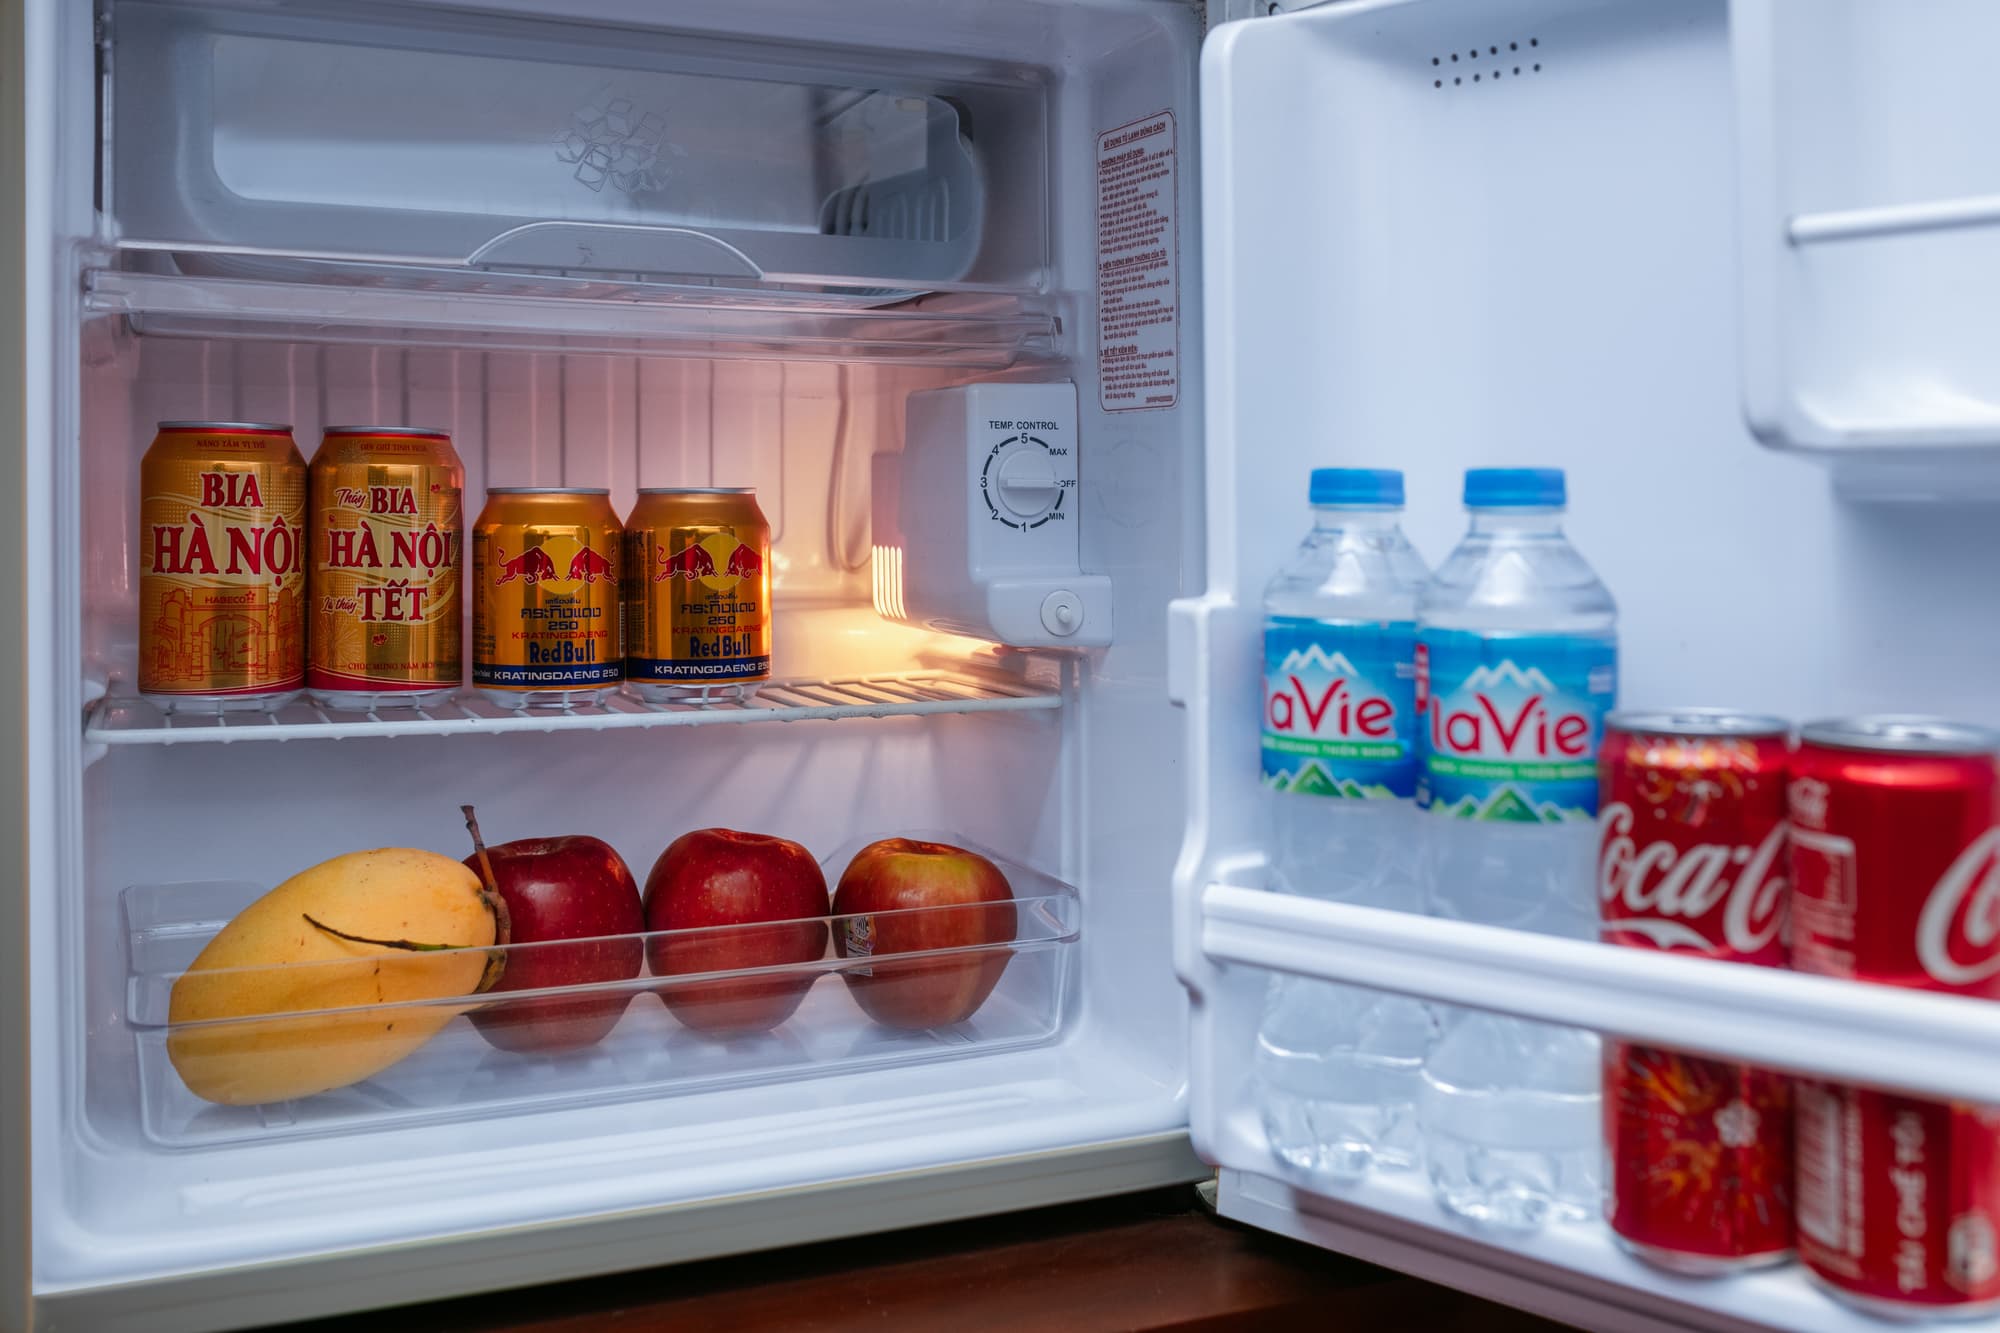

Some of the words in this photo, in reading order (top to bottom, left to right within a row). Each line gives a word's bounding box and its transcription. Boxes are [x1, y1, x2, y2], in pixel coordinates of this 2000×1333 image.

[989, 420, 1015, 430] TEMP.
[1016, 421, 1059, 430] CONTROL
[1020, 432, 1028, 444] 5
[991, 444, 999, 455] 4
[1049, 448, 1067, 456] MAX
[980, 476, 988, 488] 3
[1060, 480, 1076, 488] OFF
[200, 473, 263, 507] BIA
[370, 487, 418, 514] BIA
[991, 508, 999, 520] 2
[1048, 512, 1065, 520] MIN
[1021, 521, 1027, 533] 1
[152, 512, 219, 575] HÀ
[225, 515, 302, 588] NỘI
[328, 520, 383, 568] HÀ
[389, 522, 452, 578] NỘI
[357, 578, 428, 621] TẾT
[547, 621, 579, 630] 250
[708, 616, 736, 625] 250
[511, 631, 608, 639] KRATINGDAENG
[672, 626, 761, 634] KRATINGDAENG
[493, 670, 600, 681] KRATINGDAENG
[602, 668, 619, 678] 250
[654, 665, 755, 675] KRATINGDAENG
